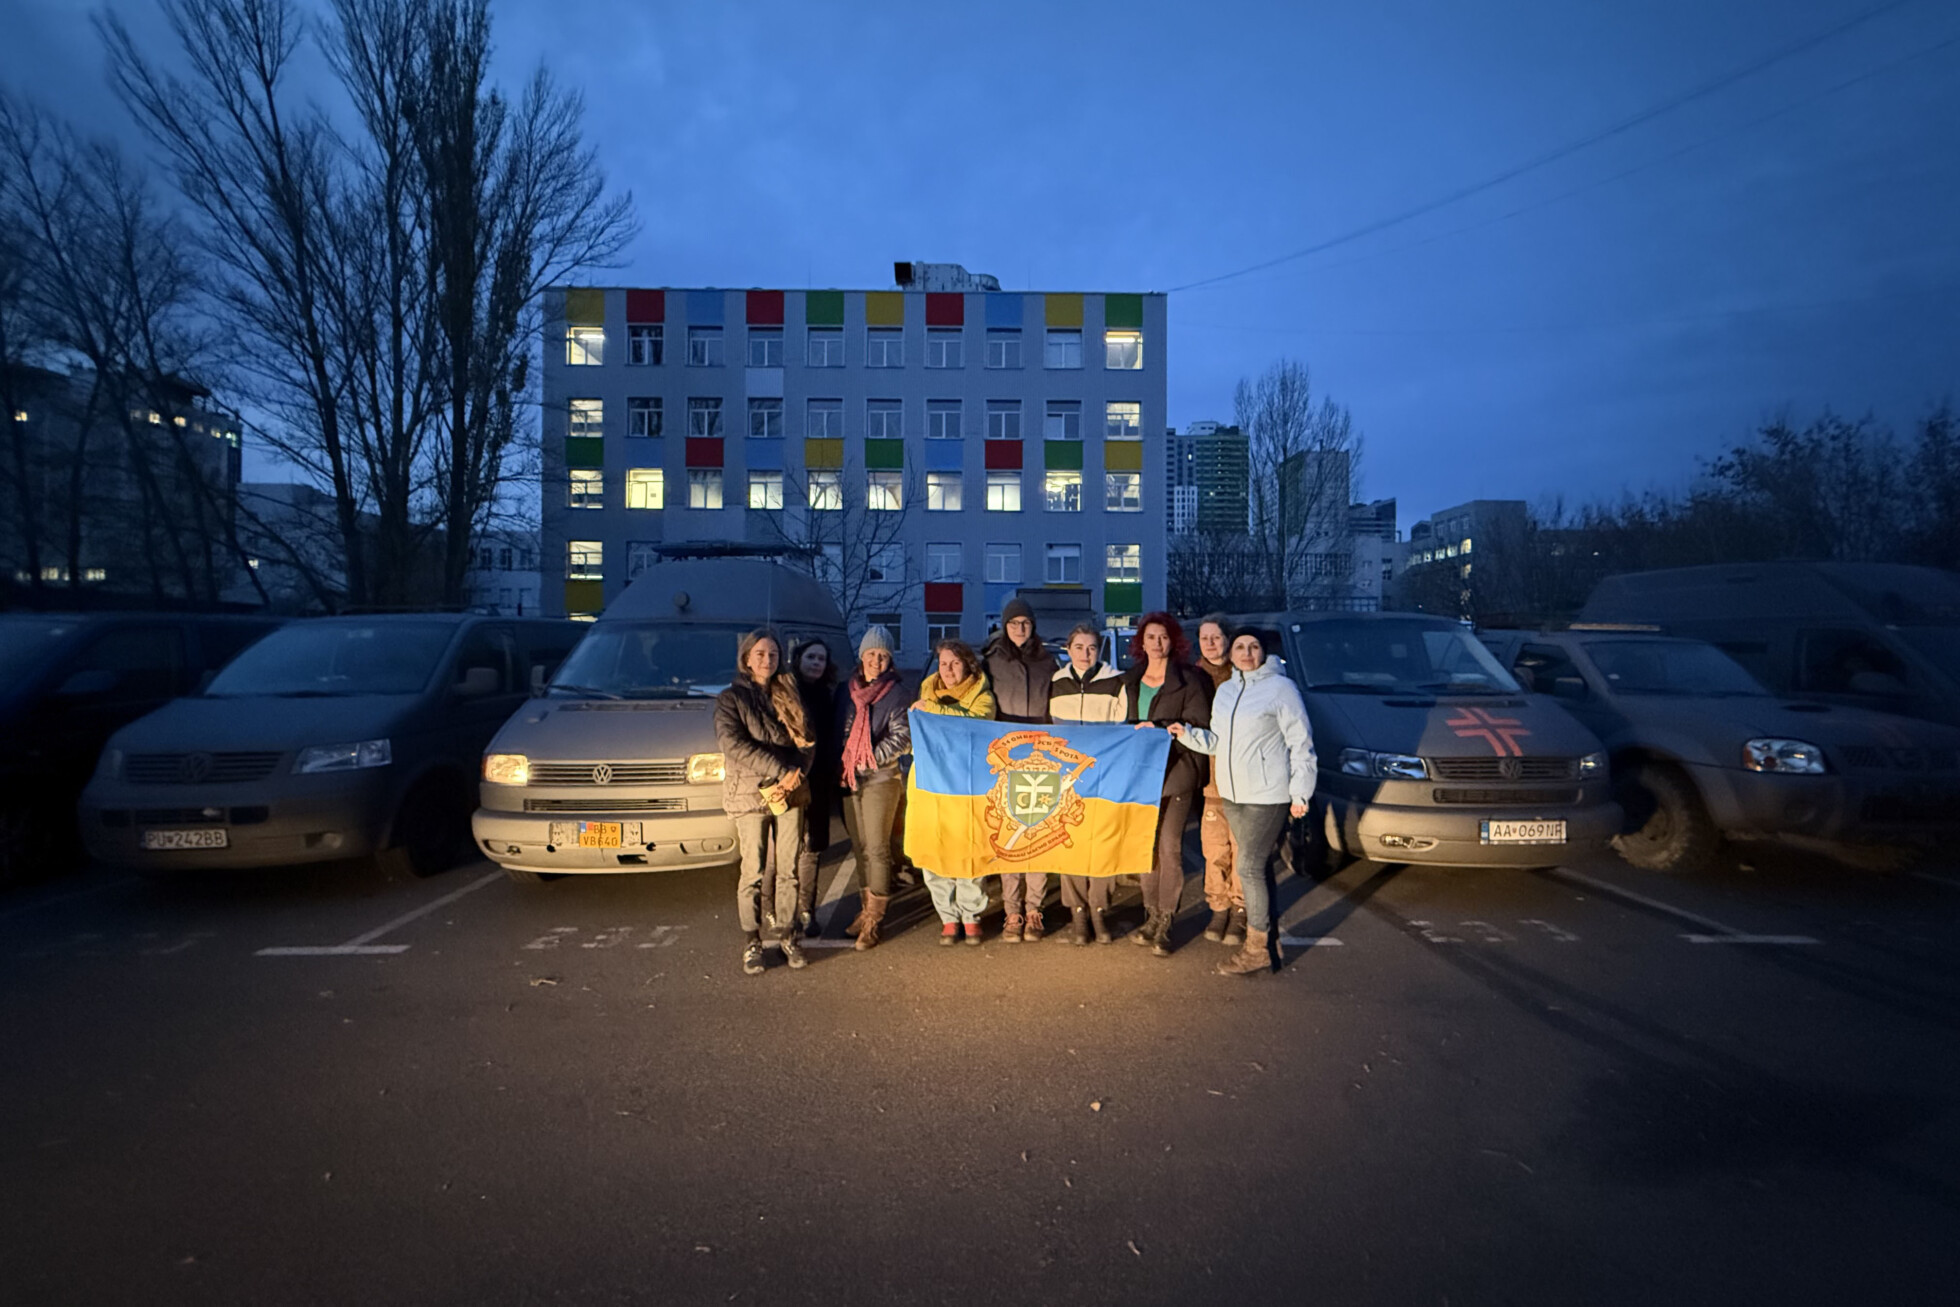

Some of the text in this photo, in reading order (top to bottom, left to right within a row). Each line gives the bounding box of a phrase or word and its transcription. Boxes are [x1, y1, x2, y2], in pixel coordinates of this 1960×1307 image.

[593, 764, 612, 785] VW
[594, 824, 607, 834] BB
[1494, 825, 1512, 837] AA
[583, 836, 618, 847] VB640
